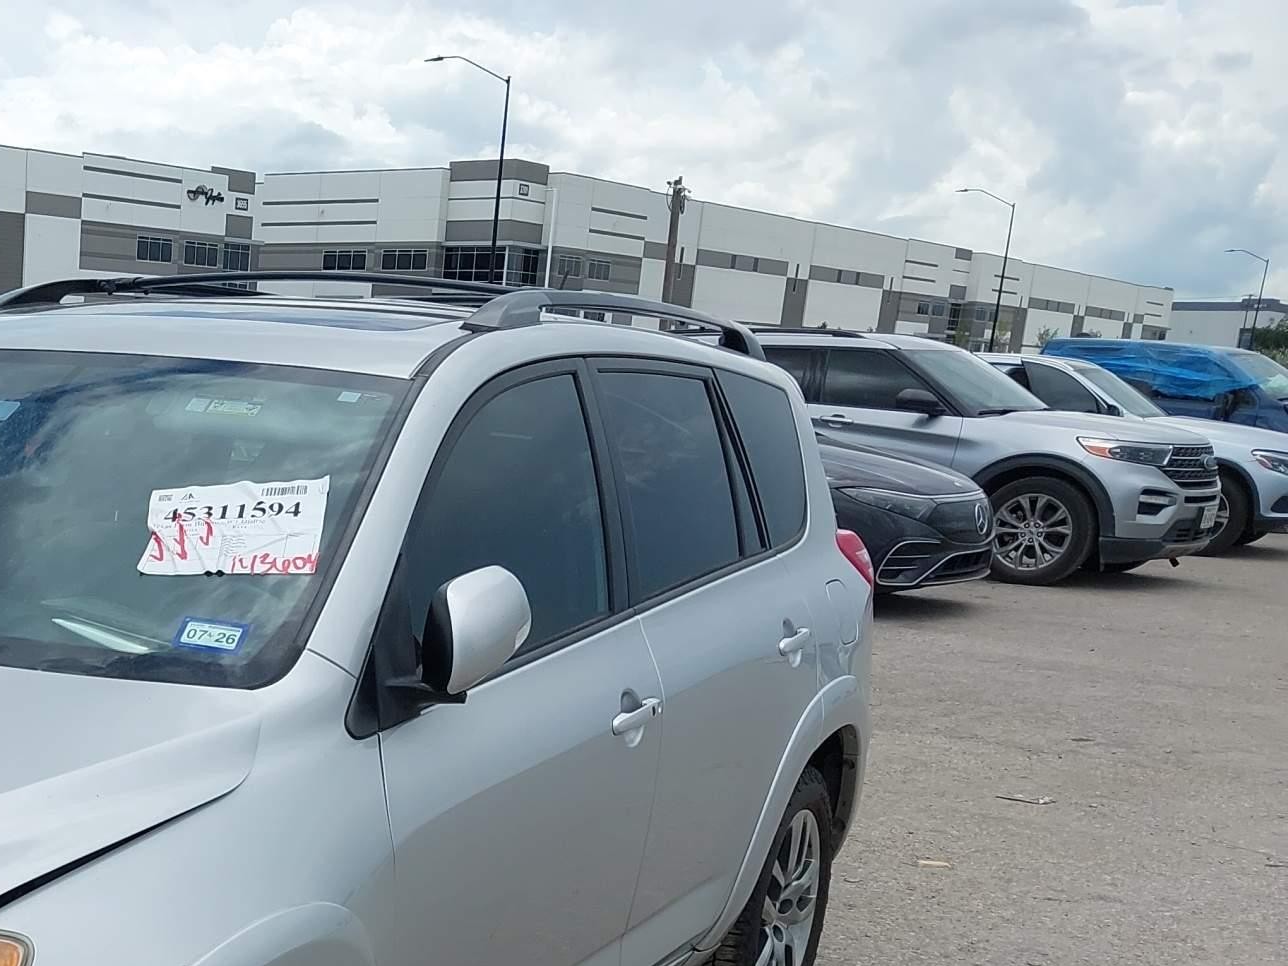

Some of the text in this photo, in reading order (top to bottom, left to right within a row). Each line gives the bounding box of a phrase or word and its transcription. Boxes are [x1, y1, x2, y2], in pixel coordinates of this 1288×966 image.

[164, 501, 301, 523] 45311594
[186, 628, 237, 645] 07 26
